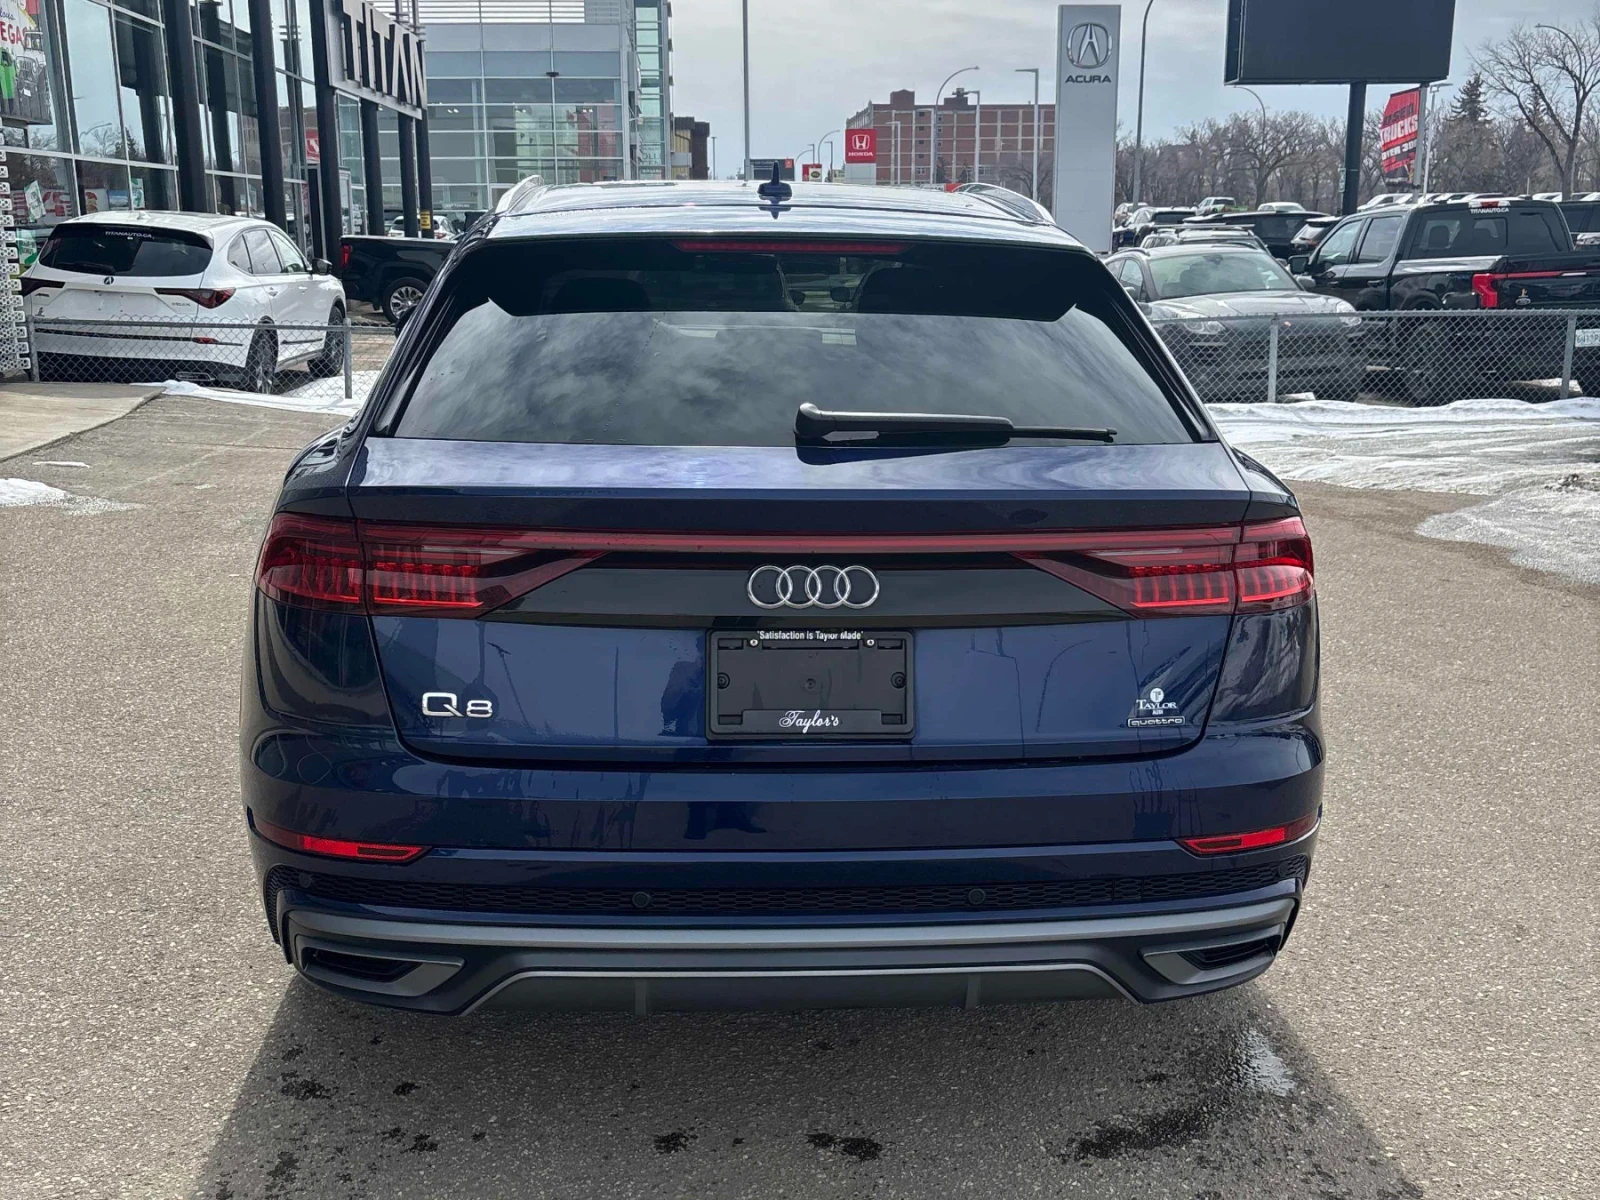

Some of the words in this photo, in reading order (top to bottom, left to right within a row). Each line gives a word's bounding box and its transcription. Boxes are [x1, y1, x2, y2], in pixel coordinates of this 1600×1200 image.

[342, 0, 428, 110] TITAN
[1065, 74, 1112, 84] ACURA
[1380, 114, 1419, 146] TRUCKS
[422, 692, 493, 718] Q8
[779, 709, 839, 734] Taylor's
[1131, 718, 1183, 726] quattro
